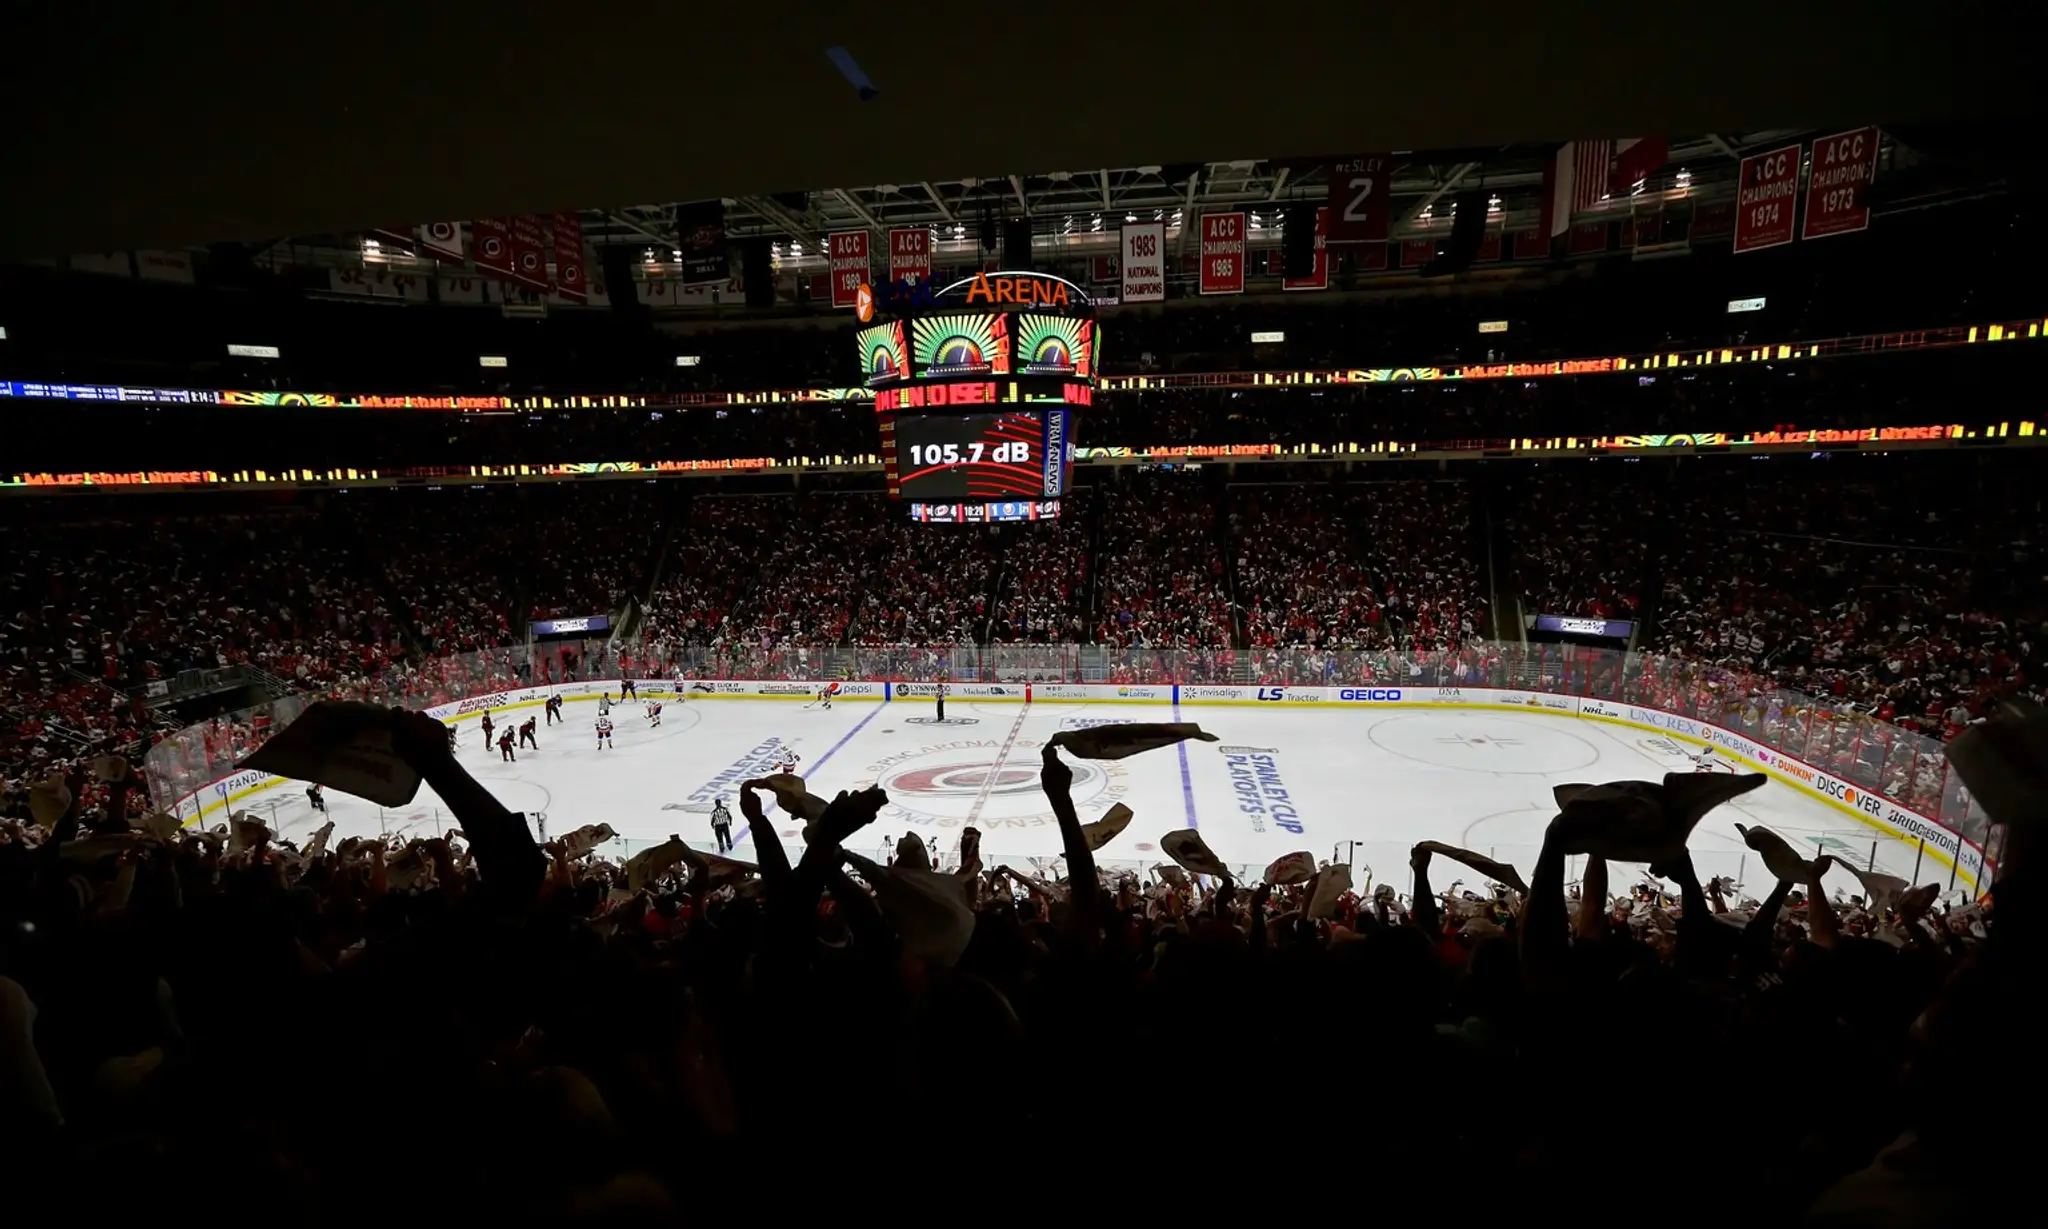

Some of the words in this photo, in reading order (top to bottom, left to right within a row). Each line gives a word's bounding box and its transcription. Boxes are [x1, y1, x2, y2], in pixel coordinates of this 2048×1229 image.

[1825, 134, 1864, 165] ACC
[1343, 177, 1373, 222] 2
[1741, 177, 1794, 206] CHAMPIONS
[1822, 187, 1855, 213] 1973
[1751, 203, 1779, 228] 1974
[1210, 218, 1235, 237] ACC
[838, 235, 860, 254] ACC
[898, 233, 921, 252] ACC
[1130, 234, 1156, 257] 1983
[1203, 240, 1242, 255] CHAMPIONS
[832, 255, 868, 271] CHAMPIONS
[893, 254, 928, 269] CHAMPIONS
[1211, 258, 1233, 277] 1985
[1127, 265, 1159, 280] NATIONAL
[965, 272, 1068, 304] ARENA
[1125, 282, 1162, 296] CHAMPIONS
[910, 442, 984, 466] 105.7
[992, 442, 1029, 463] dB
[844, 684, 872, 694] pepsi
[963, 687, 989, 695] Michael
[1006, 687, 1019, 695] Son
[1129, 690, 1156, 699] Lottery
[1200, 688, 1243, 698] invisalign
[1257, 688, 1284, 700] LS
[1287, 693, 1320, 702] Tractor
[1340, 689, 1401, 701] GEICO
[1438, 688, 1460, 696] DNA
[1630, 708, 1662, 726] UNC
[1666, 717, 1697, 735] REX
[687, 754, 756, 803] STANLEY
[751, 737, 782, 759] CUP
[1250, 754, 1292, 805] STANLEY
[1777, 759, 1815, 783] DUNKIN'
[1225, 754, 1267, 814] PLAYOFFS
[1817, 776, 1882, 817] DISCOVER
[1269, 804, 1304, 834] CUP
[1888, 809, 1959, 855] BRIDGESTONE
